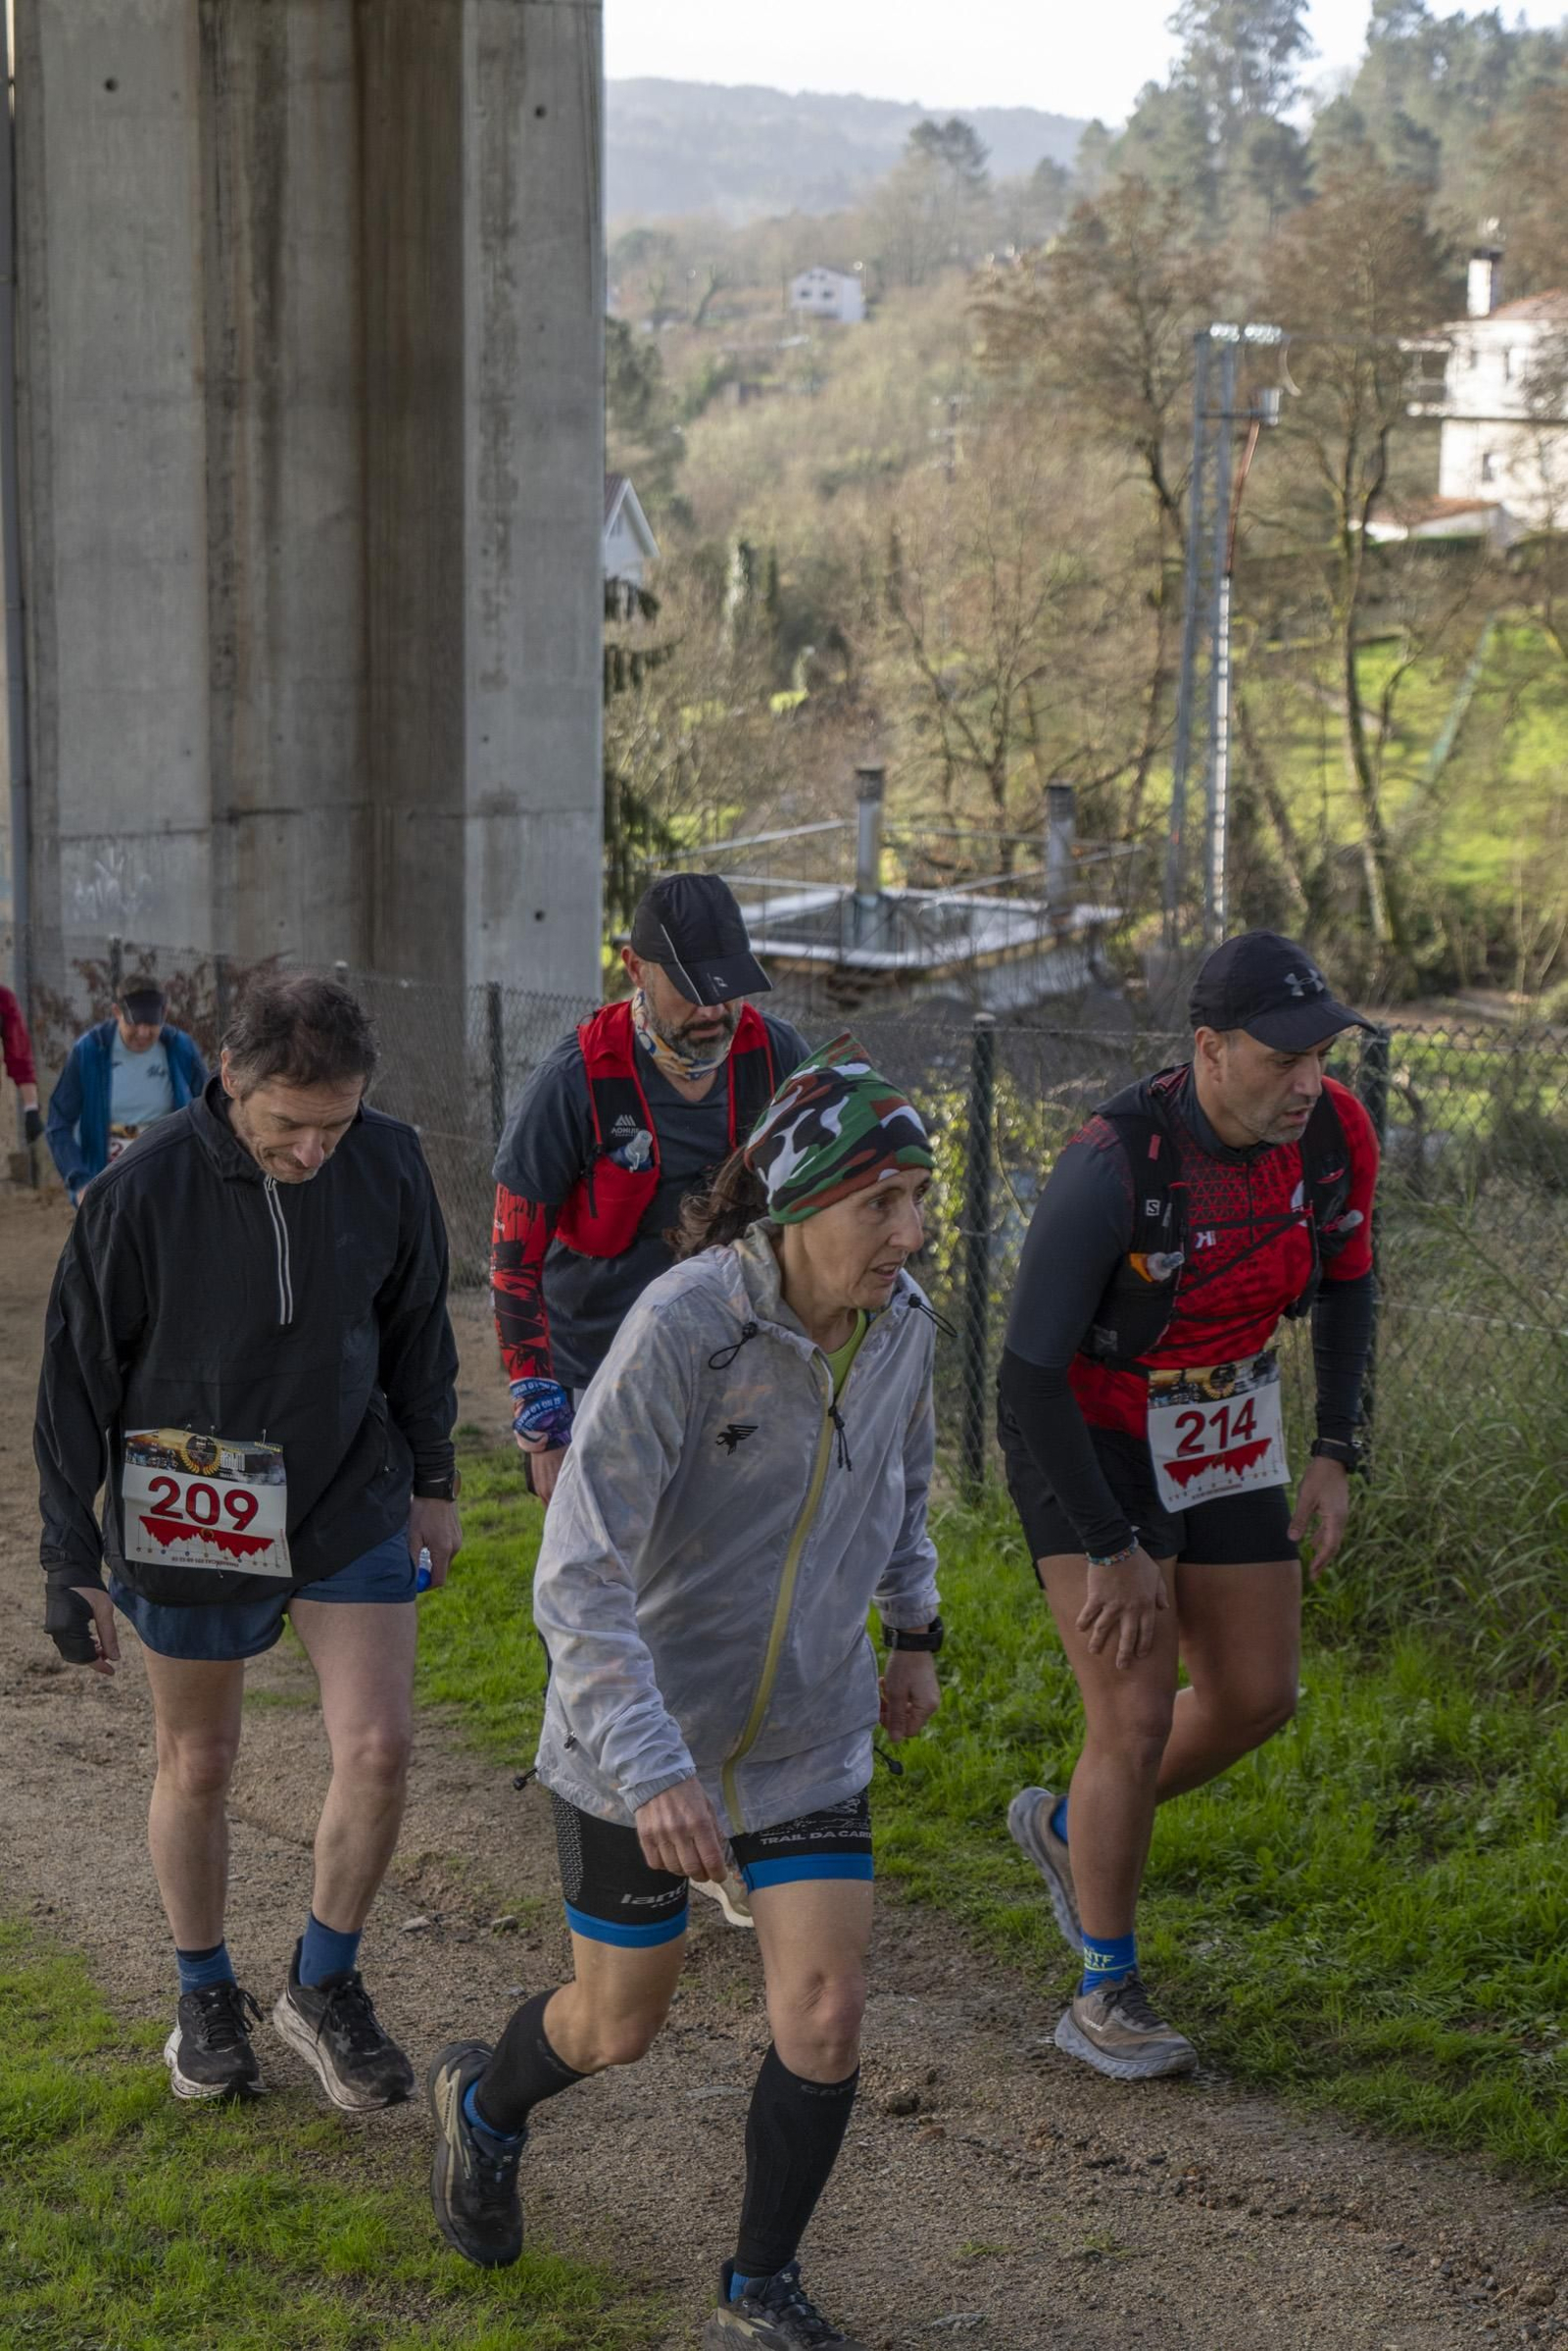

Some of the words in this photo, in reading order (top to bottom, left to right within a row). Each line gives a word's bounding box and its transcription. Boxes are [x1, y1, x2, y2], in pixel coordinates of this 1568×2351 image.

[1175, 1397, 1257, 1457] 214
[148, 1476, 260, 1531] 209
[760, 1834, 806, 1845] TRAIL
[809, 1831, 836, 1840] DA
